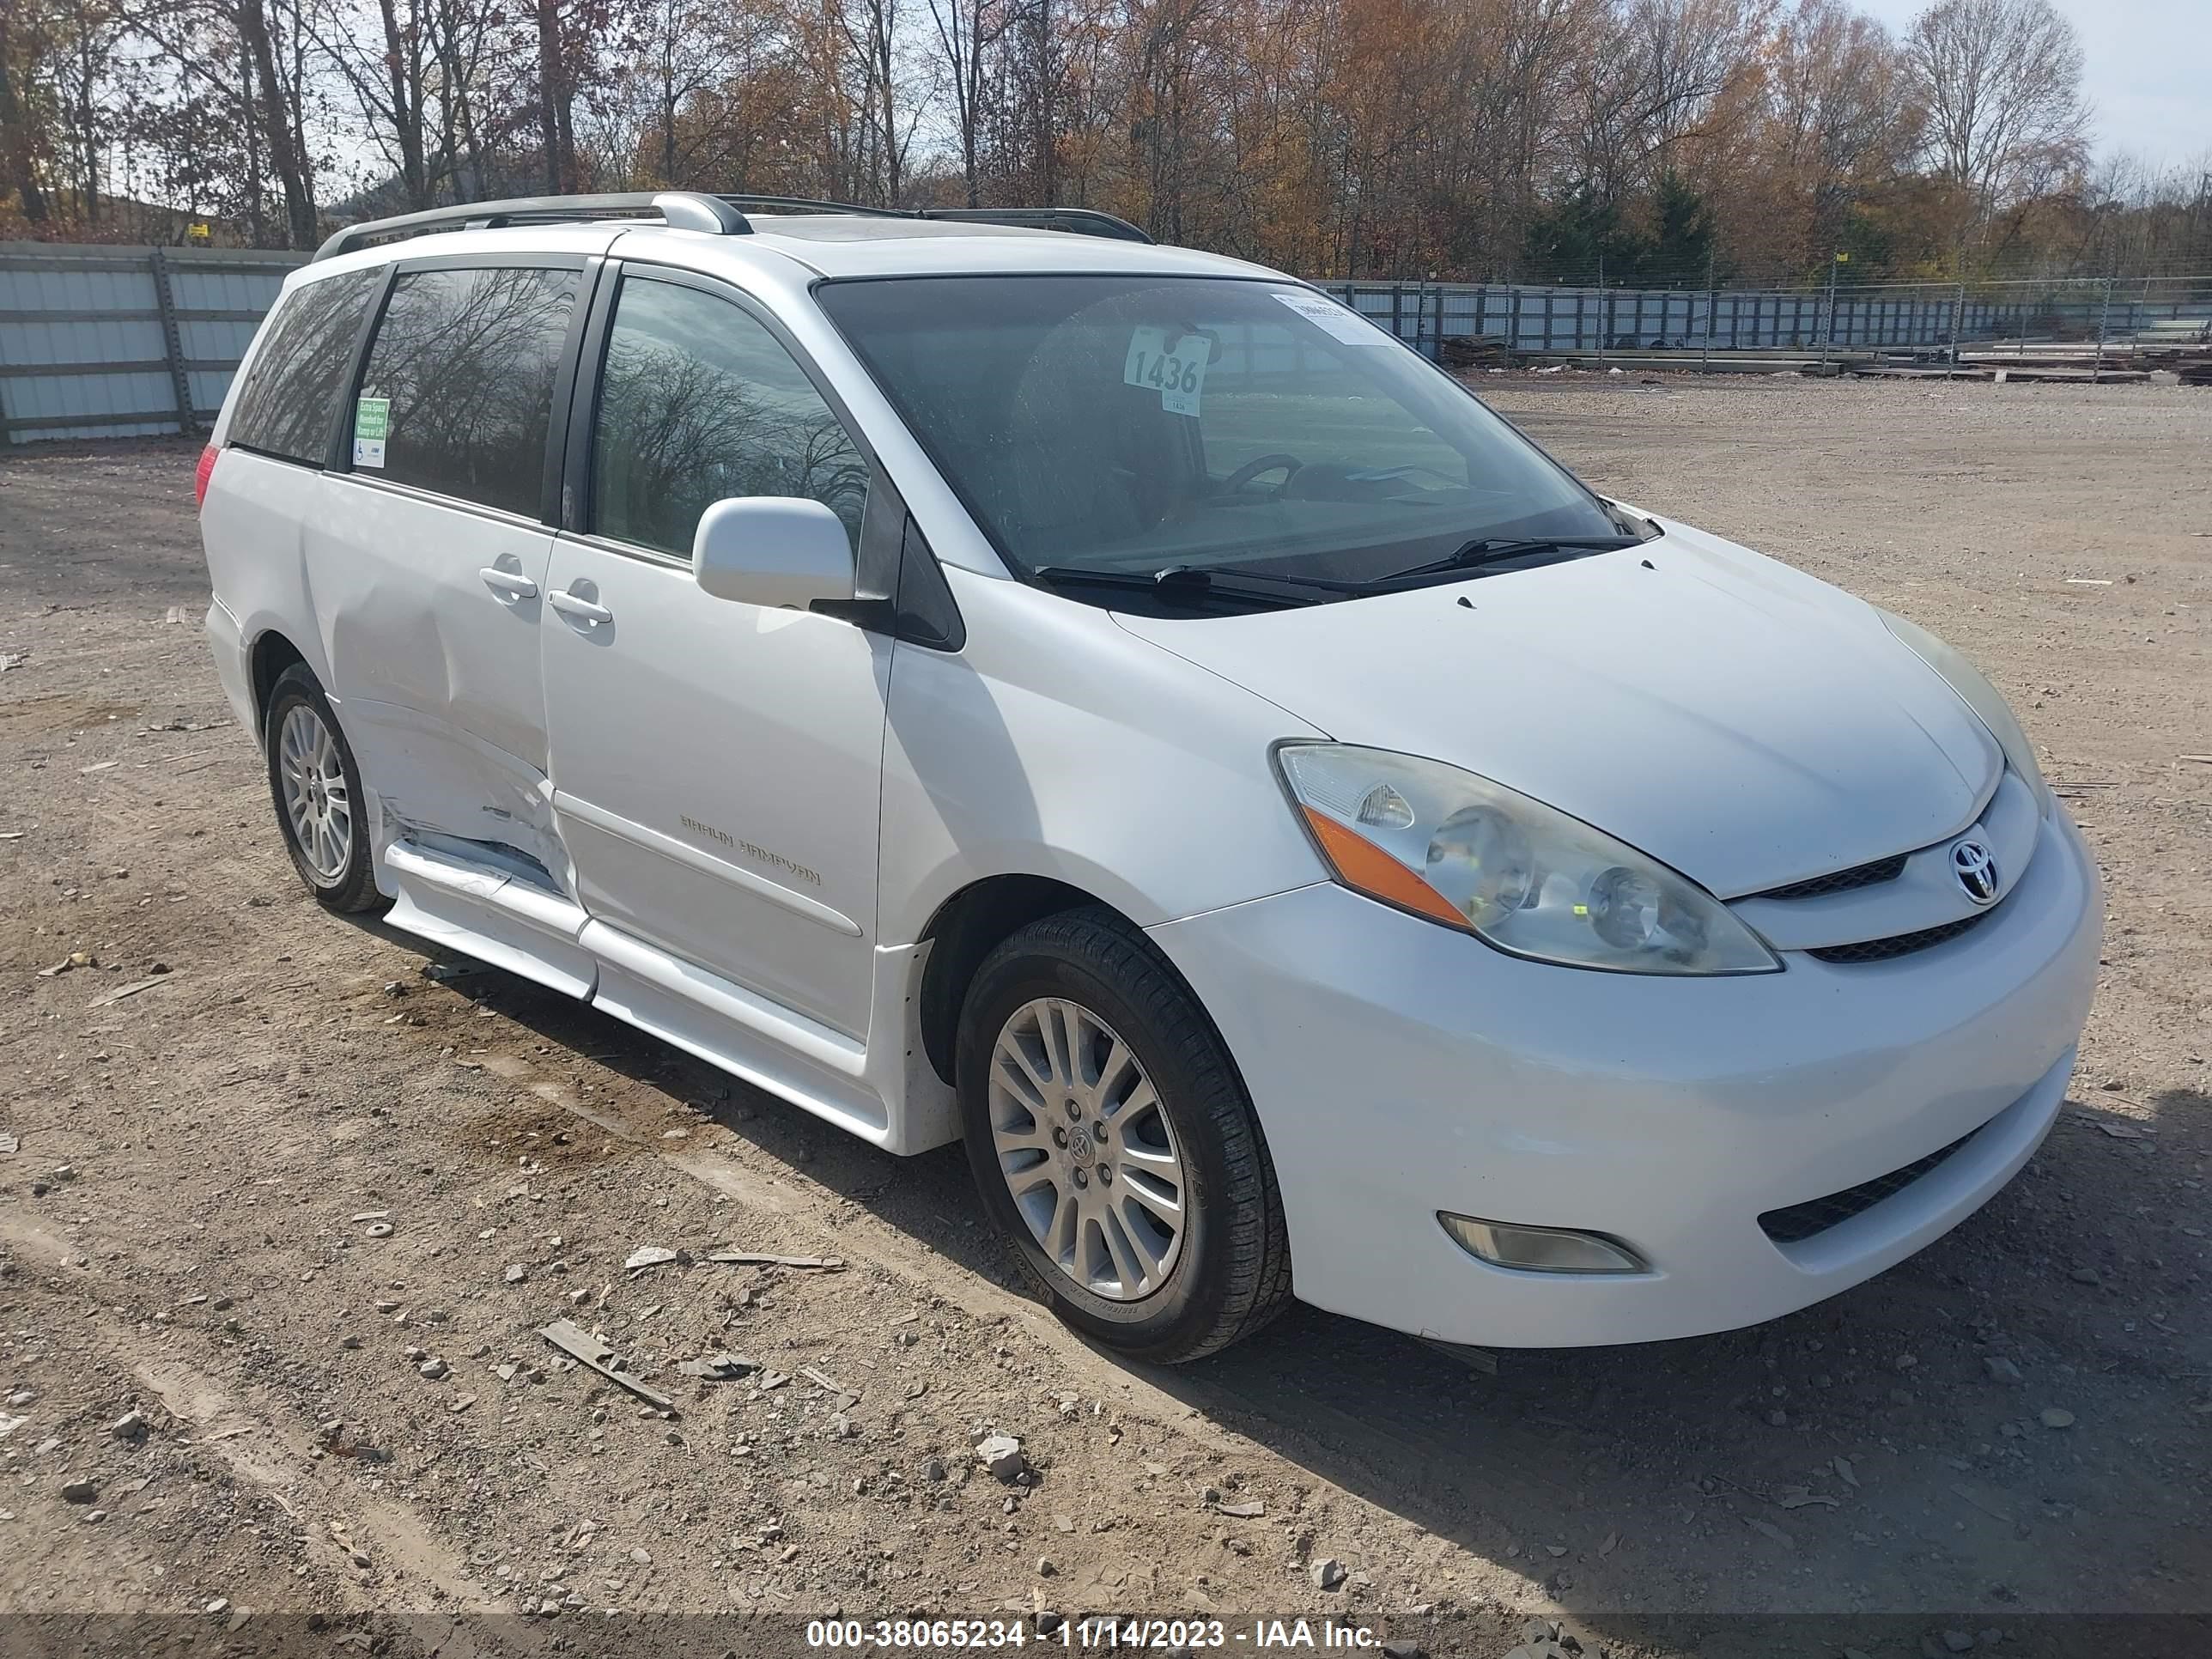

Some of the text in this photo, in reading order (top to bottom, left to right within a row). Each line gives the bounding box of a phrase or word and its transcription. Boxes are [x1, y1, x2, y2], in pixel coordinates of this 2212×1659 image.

[1134, 351, 1198, 393] 1436
[361, 401, 386, 413] Extra Space
[359, 414, 376, 425] Needed
[356, 426, 370, 438] Ramp
[375, 428, 384, 437] Lift
